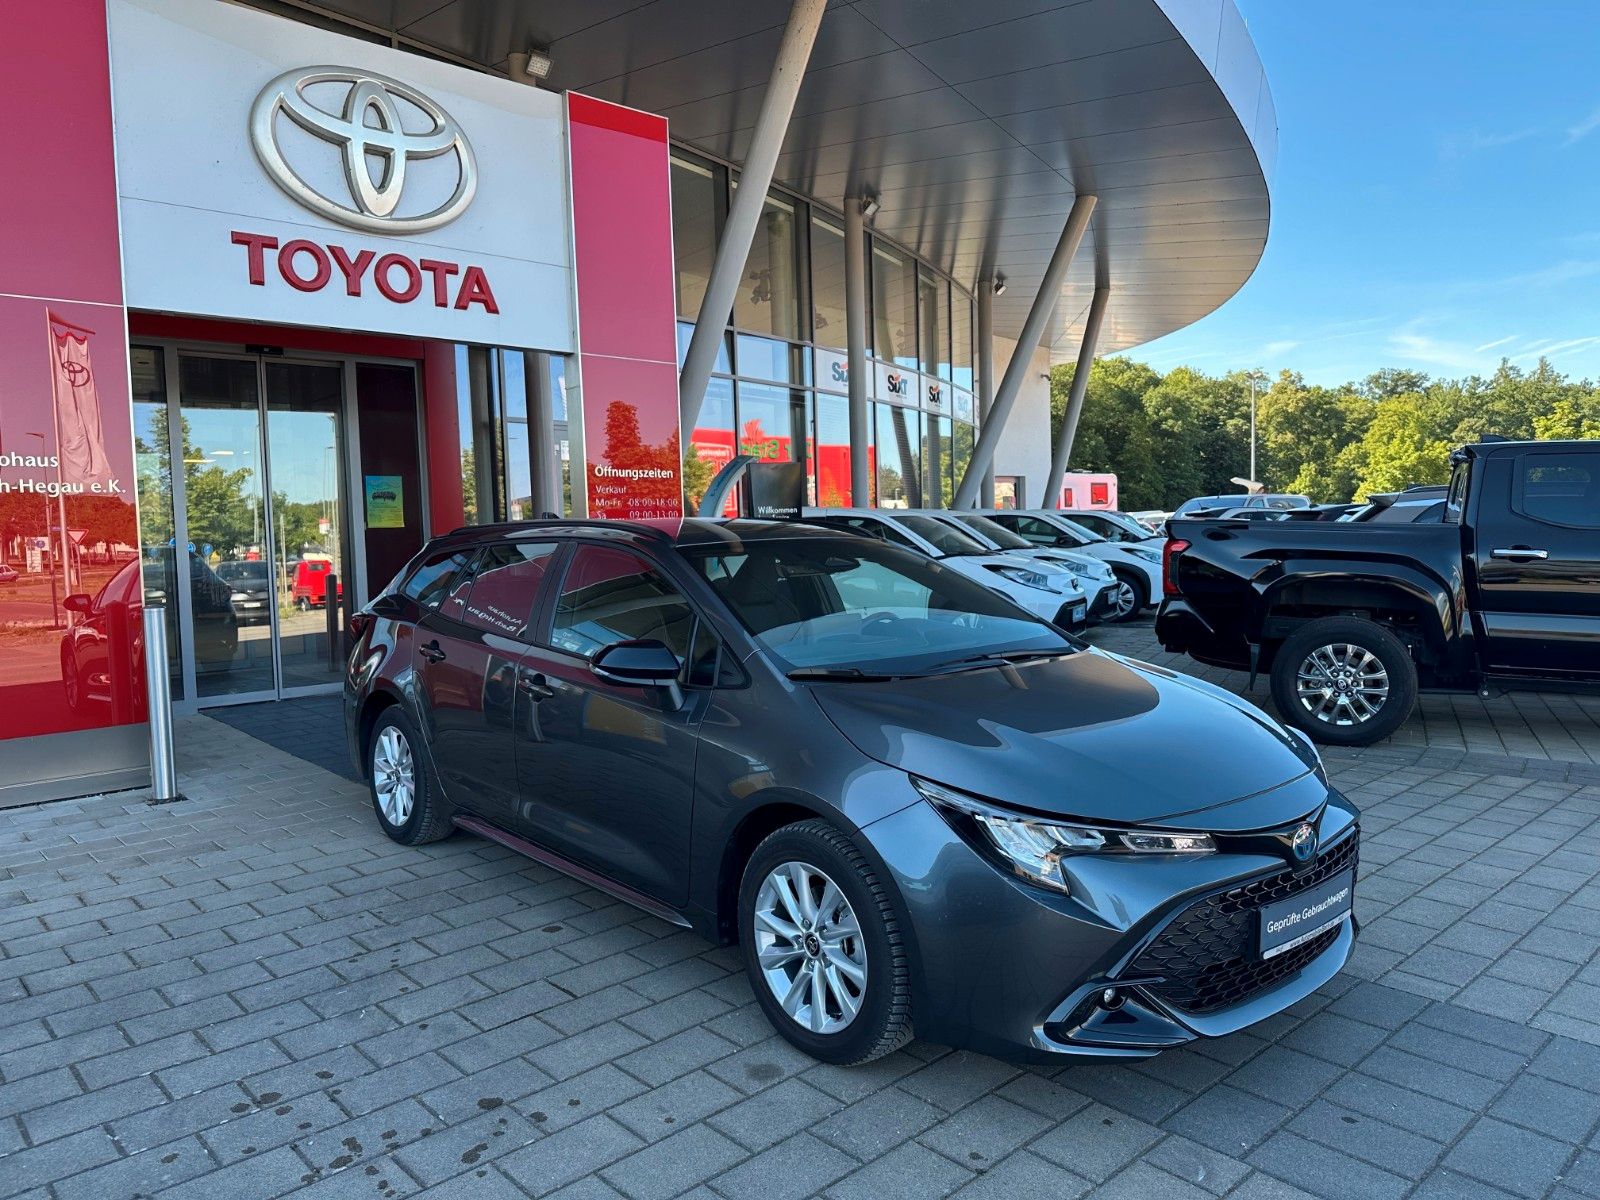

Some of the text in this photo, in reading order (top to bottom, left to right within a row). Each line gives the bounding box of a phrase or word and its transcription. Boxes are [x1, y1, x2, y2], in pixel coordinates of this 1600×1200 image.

[231, 231, 500, 314] TOYOTA
[594, 464, 674, 480] Öffnungszeiten
[90, 478, 127, 494] e.K.
[595, 484, 627, 494] Verkauf
[757, 506, 798, 514] Willkommen
[1267, 912, 1301, 933] Geprüfte
[1302, 887, 1348, 919] Gebrauchtwagen
